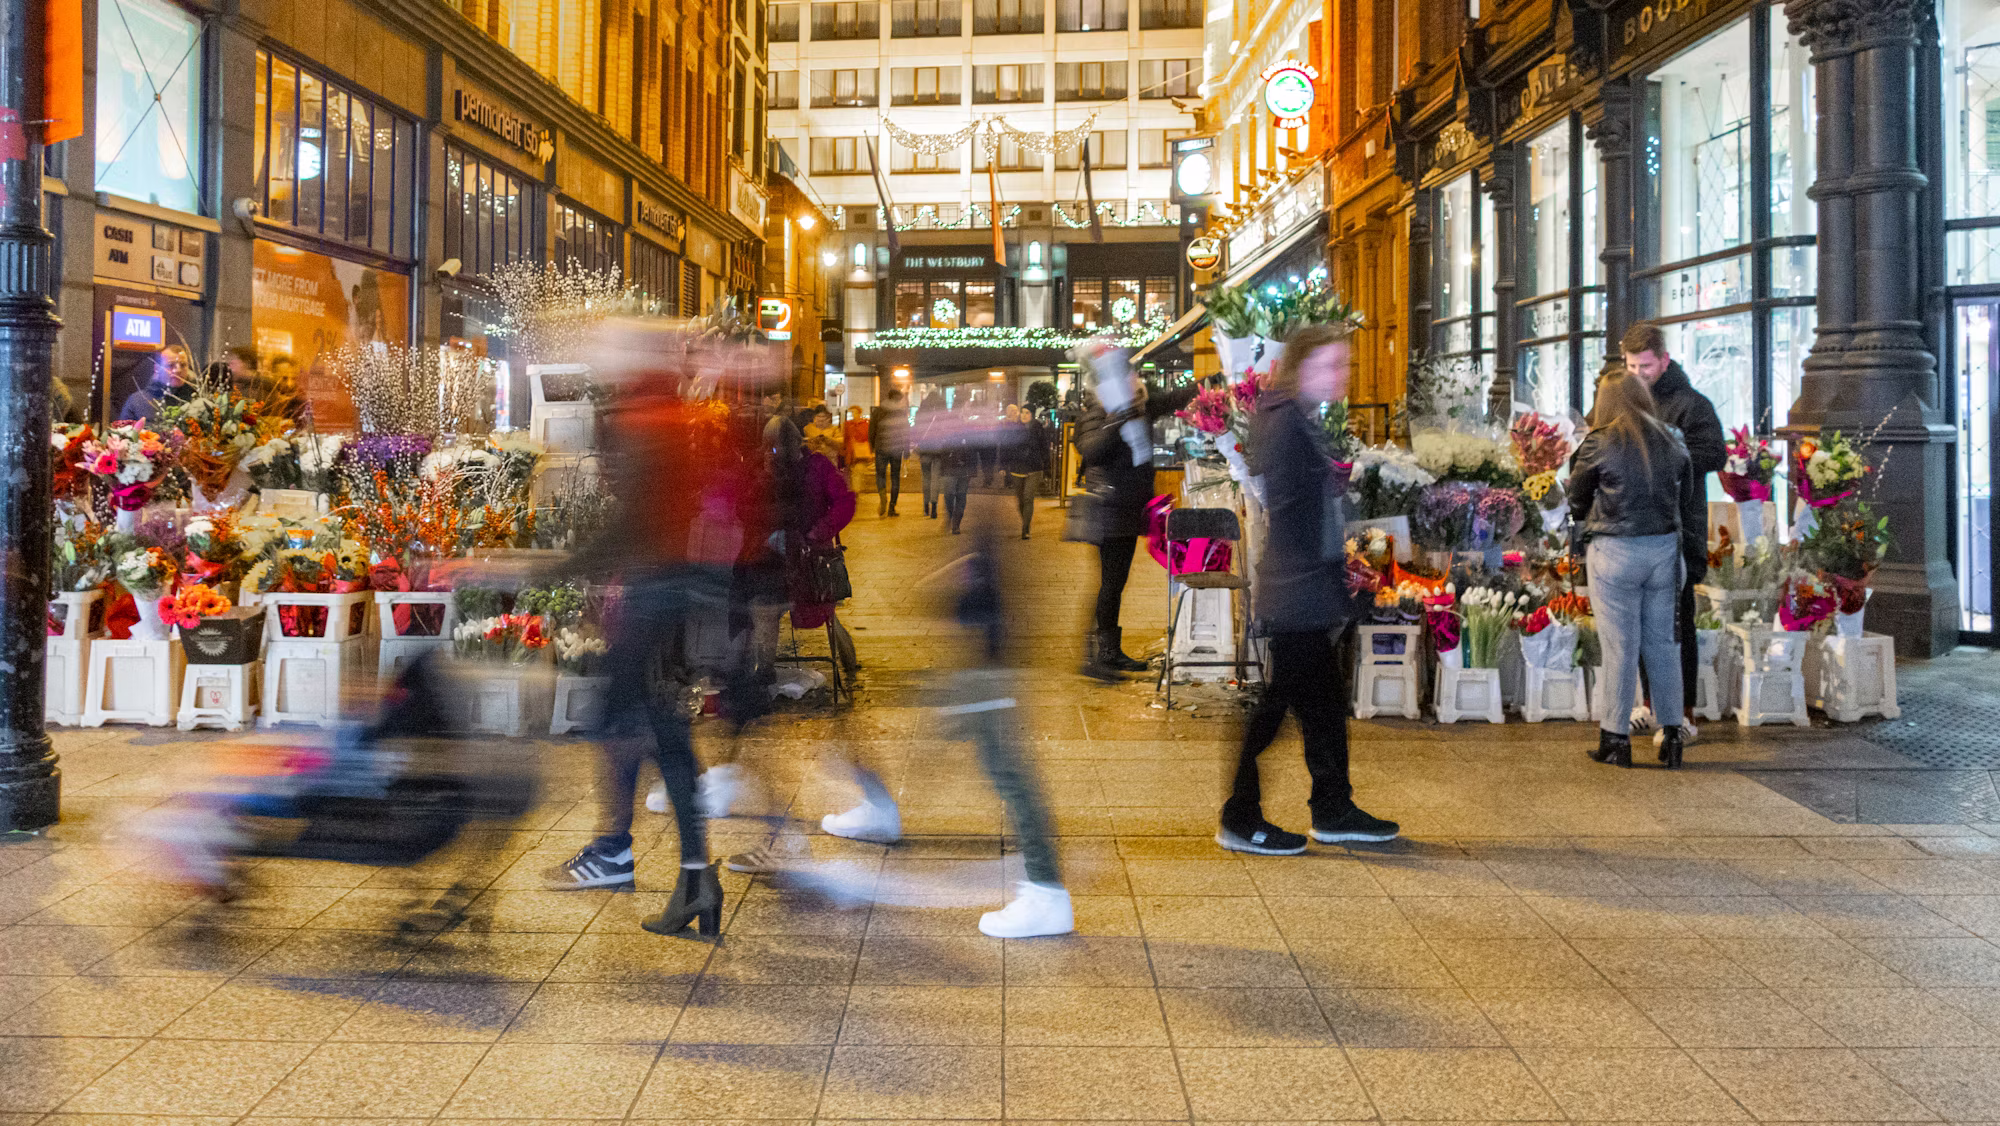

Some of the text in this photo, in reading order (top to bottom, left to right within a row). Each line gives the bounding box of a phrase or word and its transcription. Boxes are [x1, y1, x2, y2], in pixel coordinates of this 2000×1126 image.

[462, 92, 538, 155] permanent tsb
[103, 225, 133, 243] CASH
[108, 248, 128, 264] ATM
[905, 256, 985, 268] THE WESTBURY
[267, 271, 292, 291] MORE
[293, 277, 319, 296] FROM
[279, 295, 326, 318] MORTGAGE
[125, 318, 151, 338] ATM
